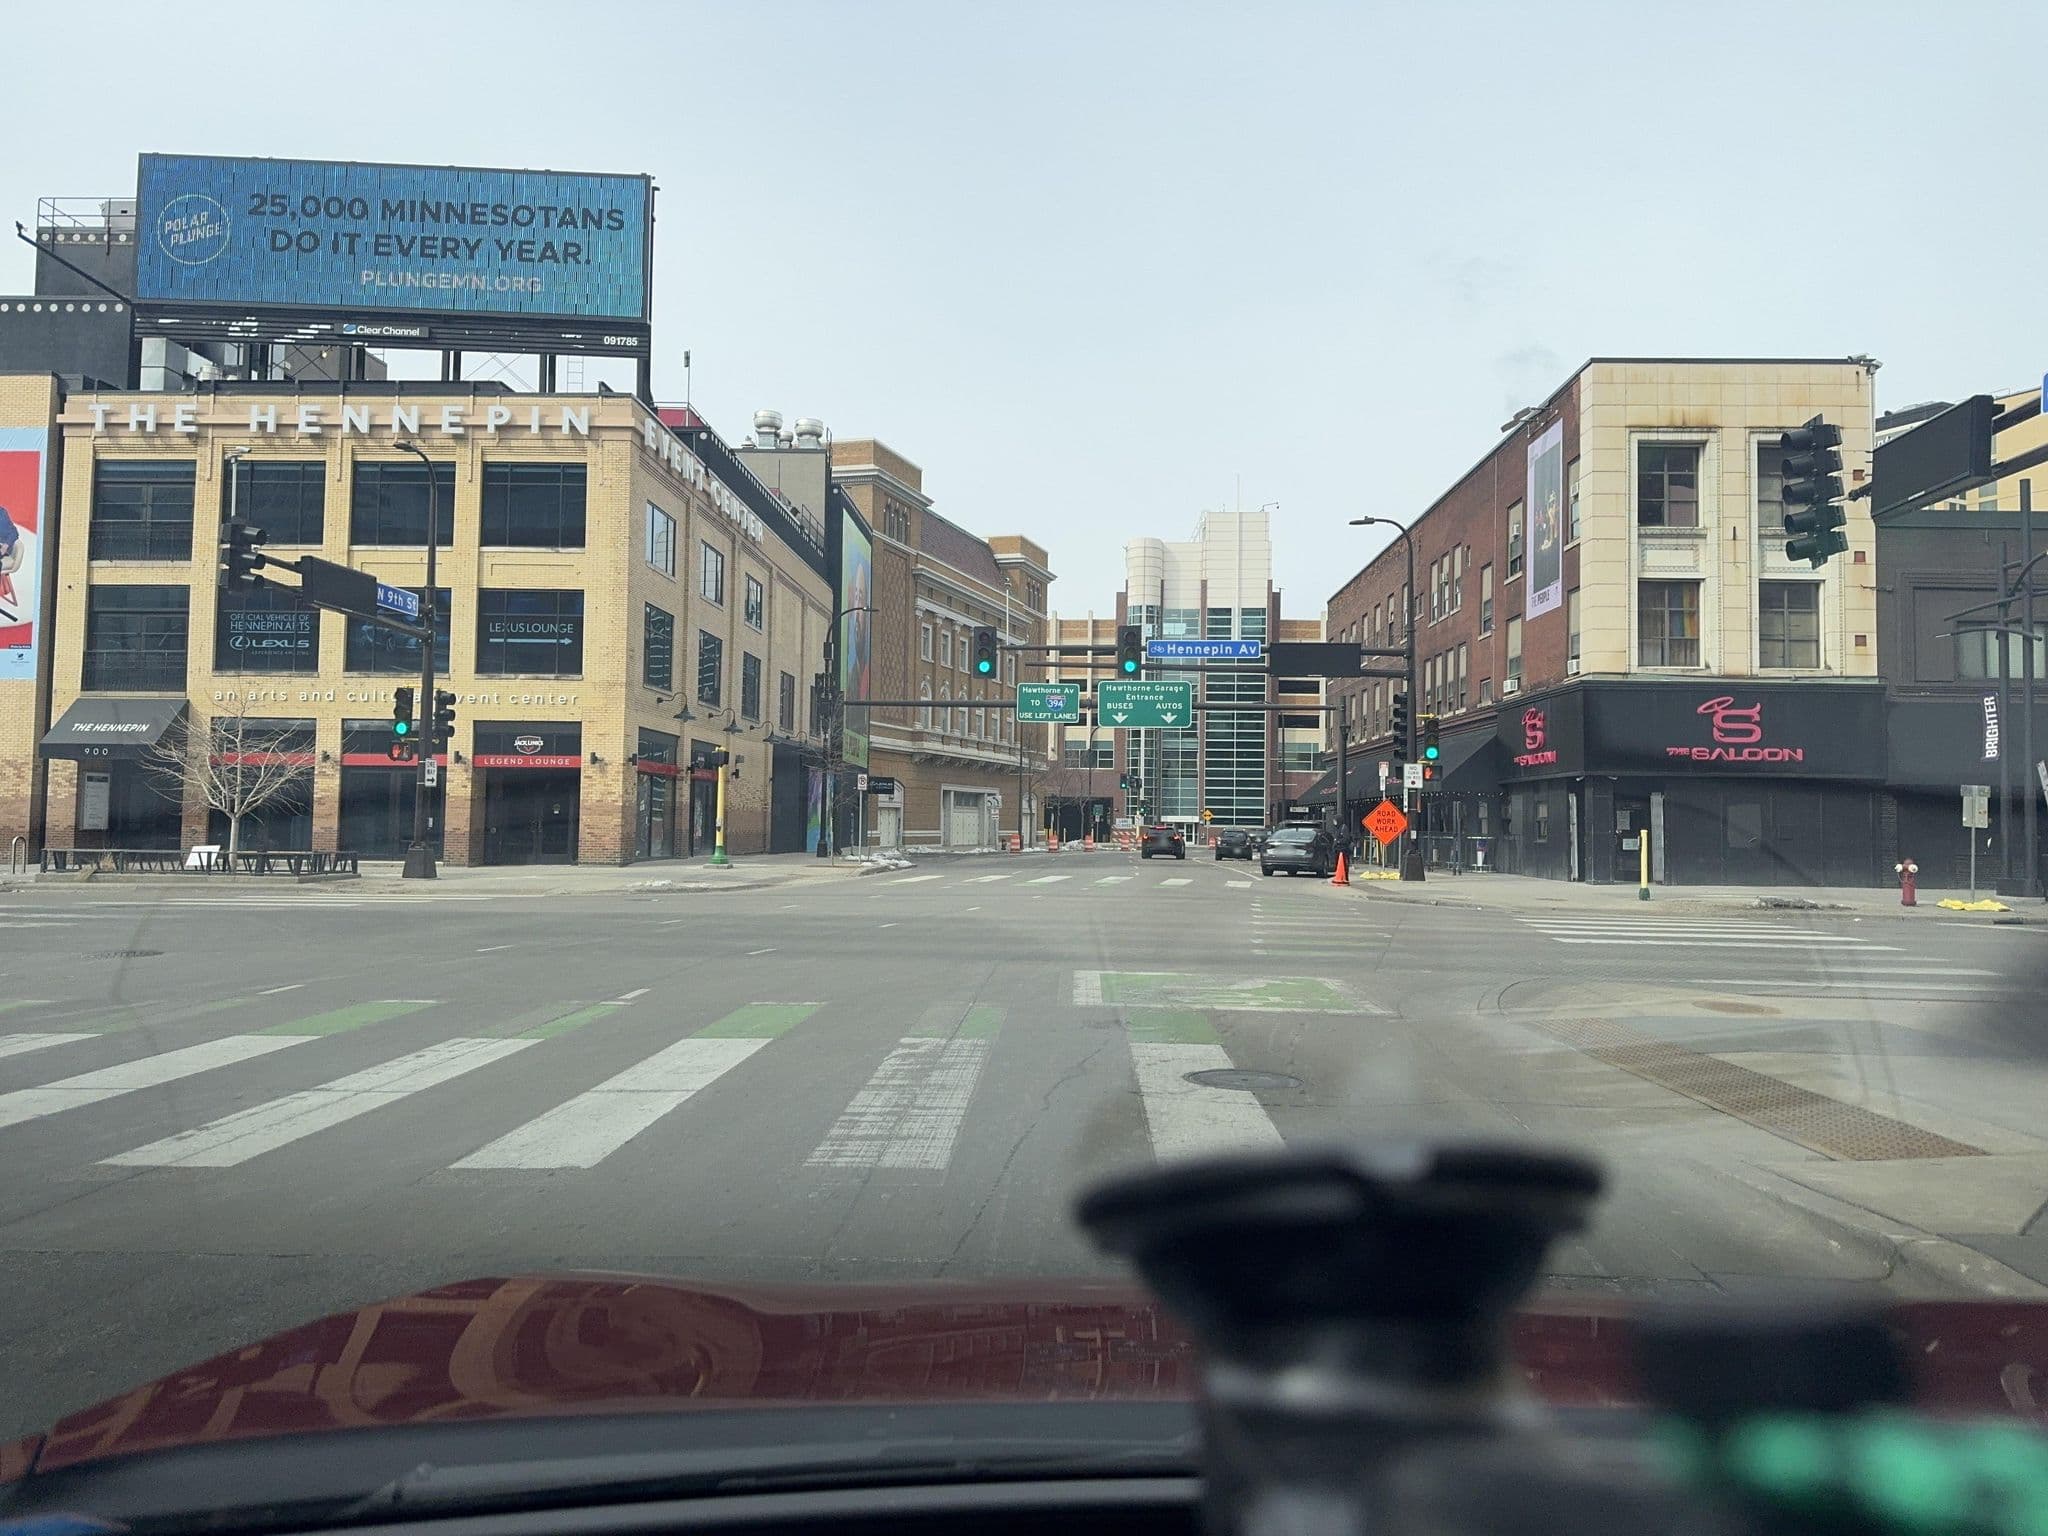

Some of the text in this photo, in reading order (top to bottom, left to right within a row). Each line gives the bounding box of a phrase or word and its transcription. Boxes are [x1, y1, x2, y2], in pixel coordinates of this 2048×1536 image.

[248, 192, 625, 231] 25,000 MINNESOTANS
[165, 212, 209, 234] POLAR
[170, 222, 222, 247] PLUNGE
[271, 229, 592, 265] DO IT EVERY YEAR.
[361, 270, 544, 293] PLUNGEMN.ORG
[357, 325, 419, 336] Clear Channel
[604, 336, 638, 347] 091785
[88, 403, 590, 436] THE HENNEPIN
[644, 417, 705, 492] EVENT
[710, 479, 763, 544] CENTER
[377, 587, 417, 611] N 9th St
[489, 622, 574, 634] LEXUS LOUNGE
[252, 639, 310, 649] LEXUS
[1166, 643, 1258, 657] Hennepin Av
[1022, 686, 1061, 694] Hawthorne
[1106, 684, 1184, 693] Hawthorne Garage
[214, 690, 235, 701] an
[249, 689, 288, 701] arts
[300, 689, 335, 701] and
[454, 692, 501, 705] vent
[510, 693, 579, 706] center
[1126, 693, 1164, 701] Entrance
[1049, 699, 1063, 708] 394
[1106, 702, 1183, 710] BUSES AUTOS
[72, 722, 150, 732] THE HENNEPIN
[1984, 696, 1999, 759] BRIGHTER
[84, 747, 109, 756] 900
[1691, 747, 1804, 761] SALOON
[484, 757, 570, 766] LEGEND LOUNGE
[1376, 810, 1397, 818] ROAD
[1374, 825, 1399, 833] AHEAD
